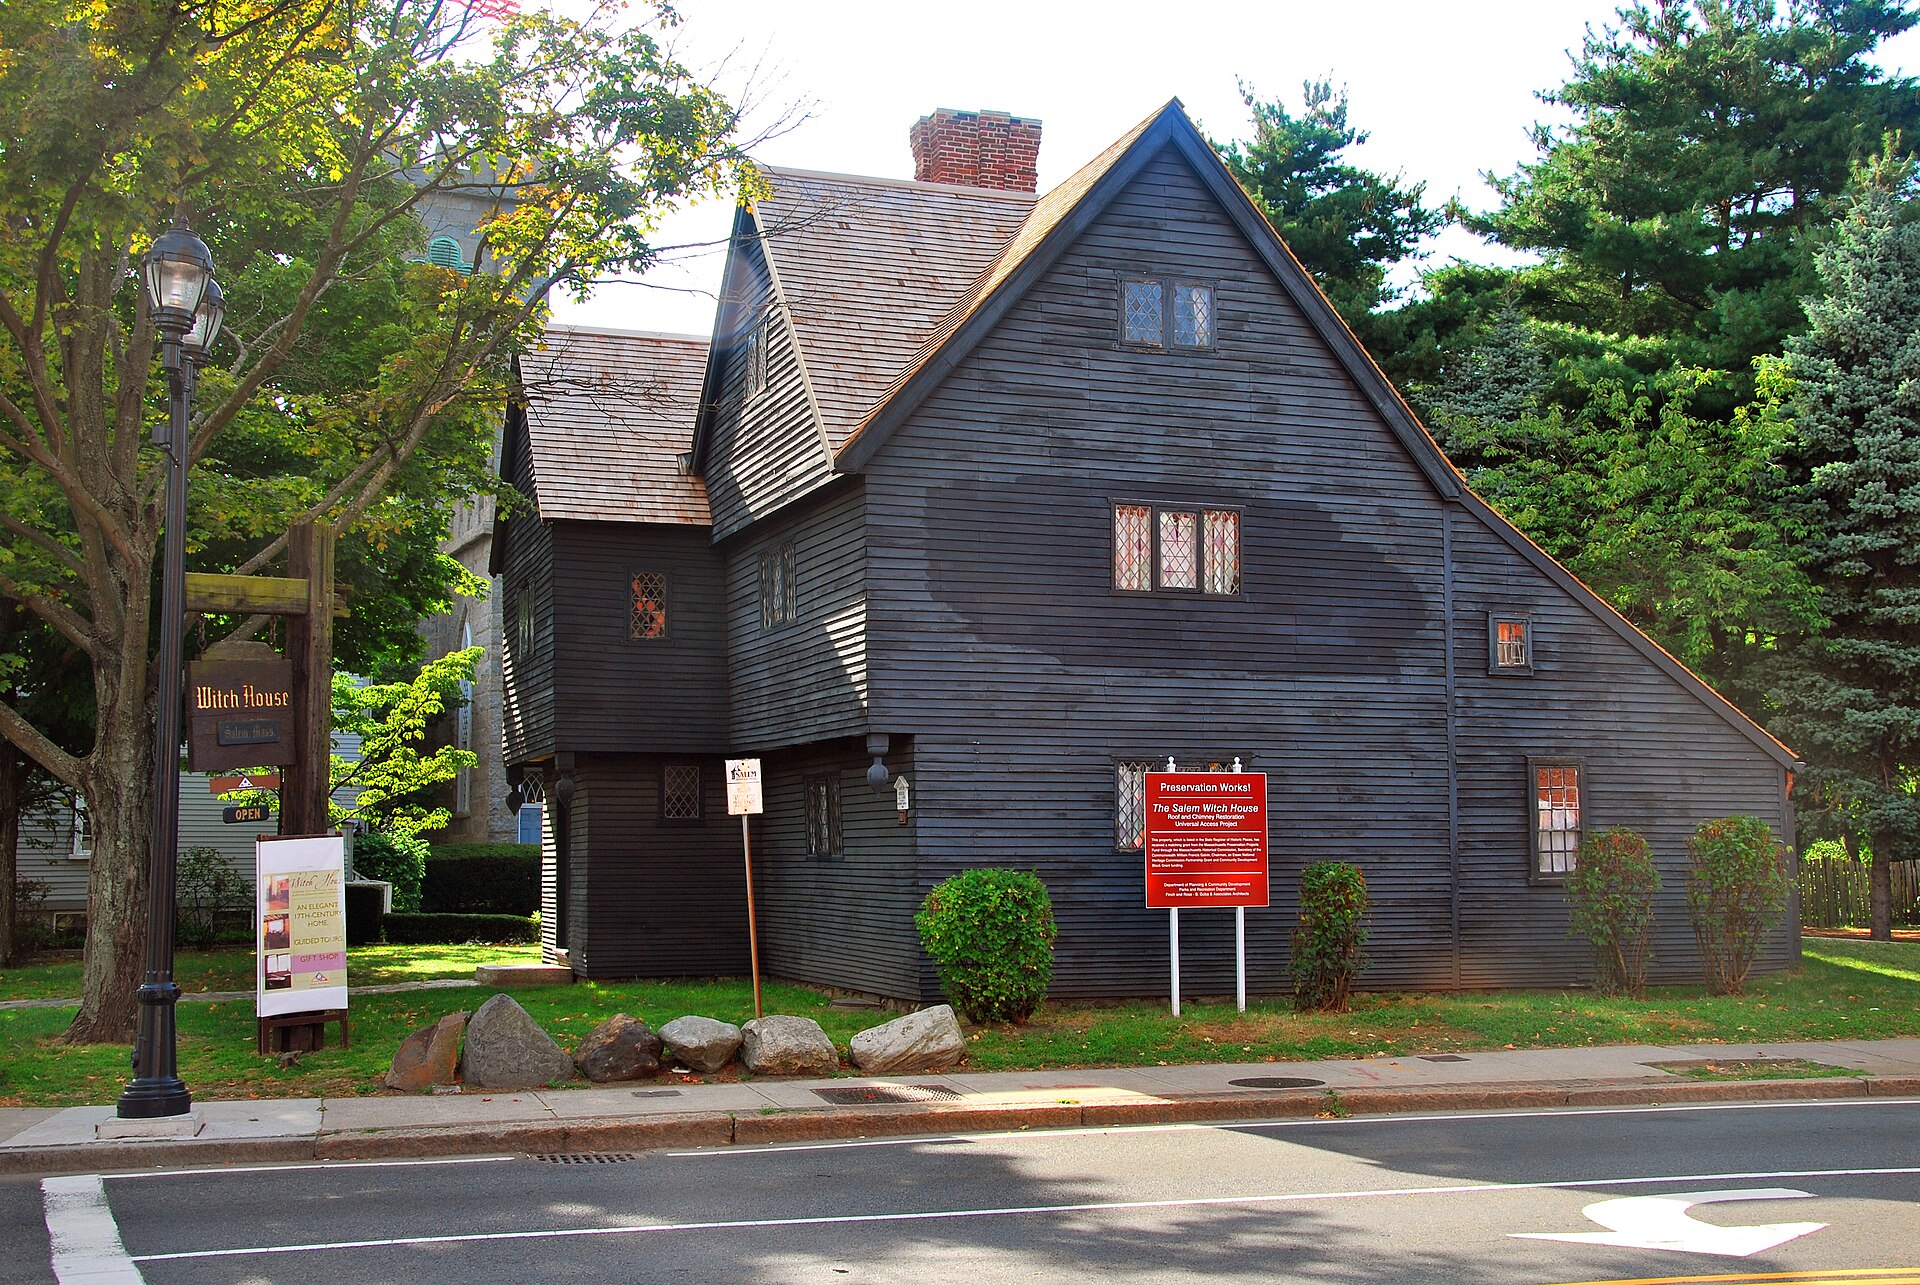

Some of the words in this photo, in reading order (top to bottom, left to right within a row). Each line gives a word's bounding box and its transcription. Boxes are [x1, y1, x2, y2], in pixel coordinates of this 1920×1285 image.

[197, 686, 239, 709] Witch
[243, 685, 289, 708] House
[1160, 782, 1217, 792] Preservation
[1219, 782, 1251, 792] Works!
[1153, 803, 1170, 813] The
[1172, 803, 1200, 813] Salem
[1203, 803, 1228, 813] Witch
[1230, 803, 1259, 813] House
[235, 808, 261, 820] OPEN
[291, 874, 318, 888] Witch
[295, 911, 342, 919] 17TH-CENTURY
